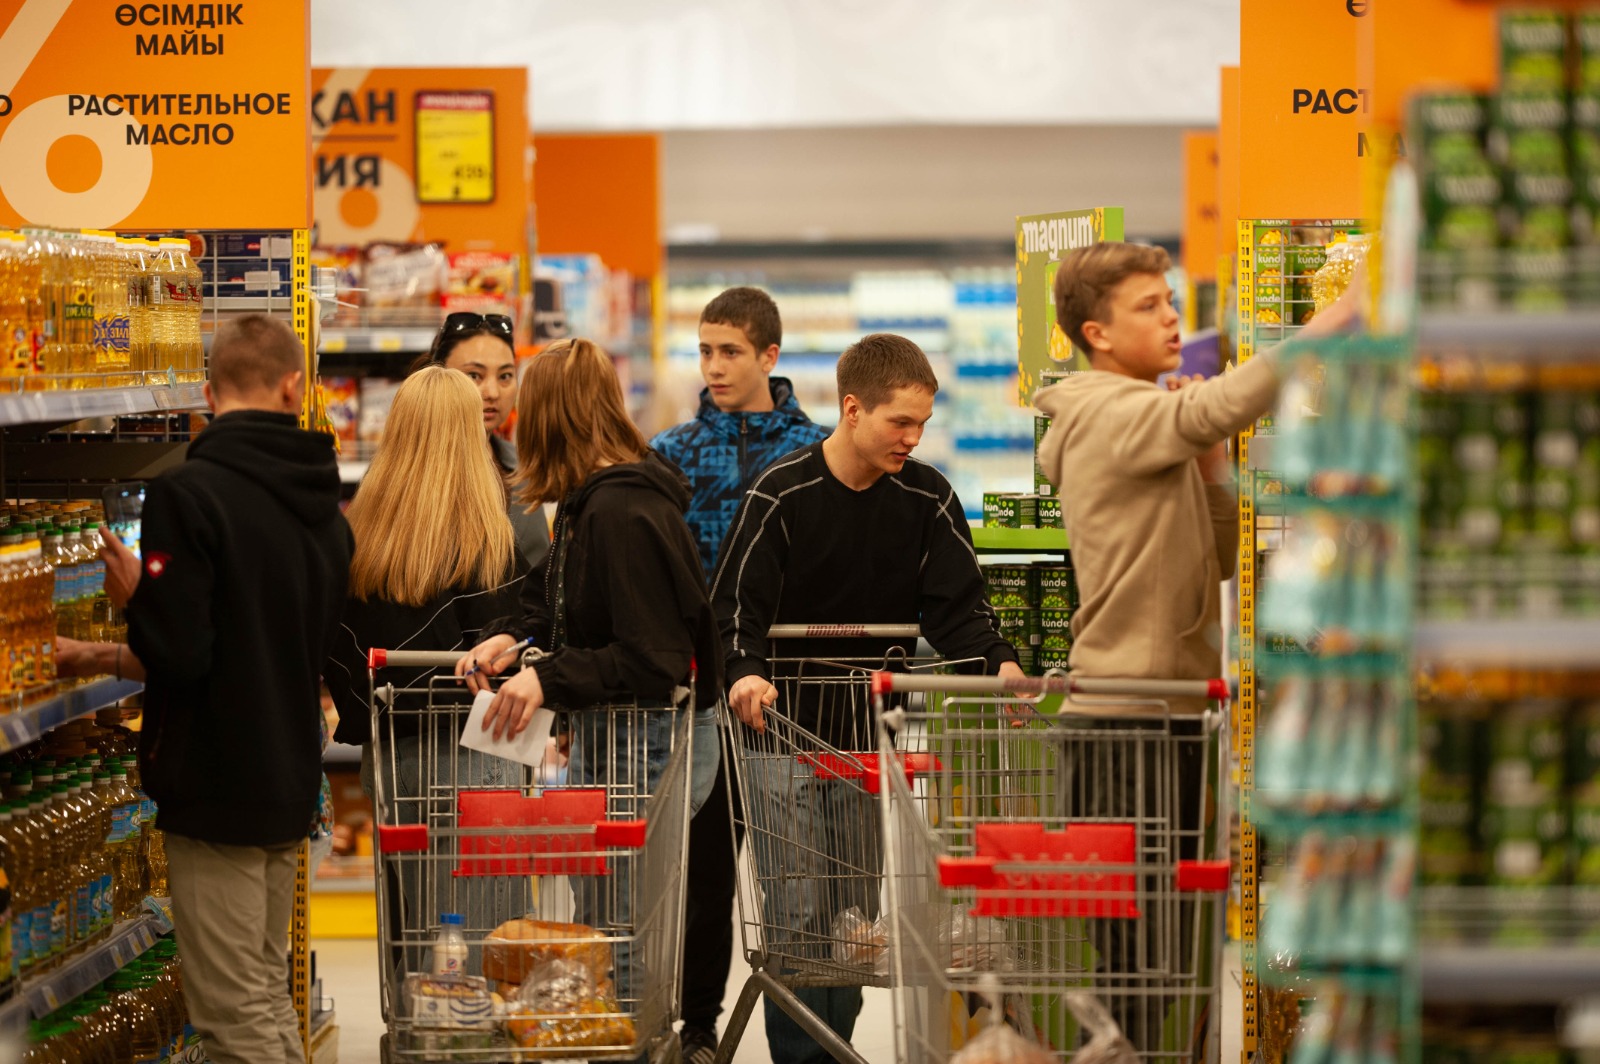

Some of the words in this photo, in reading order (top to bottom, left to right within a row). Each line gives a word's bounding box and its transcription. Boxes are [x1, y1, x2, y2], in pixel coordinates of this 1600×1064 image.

[115, 3, 244, 28] ӨСІМДІК
[135, 30, 225, 56] МАЙЫ
[68, 92, 291, 117] РАСТИТЕЛЬНОЕ
[125, 123, 234, 147] МАСЛО
[1023, 216, 1093, 259] magnum
